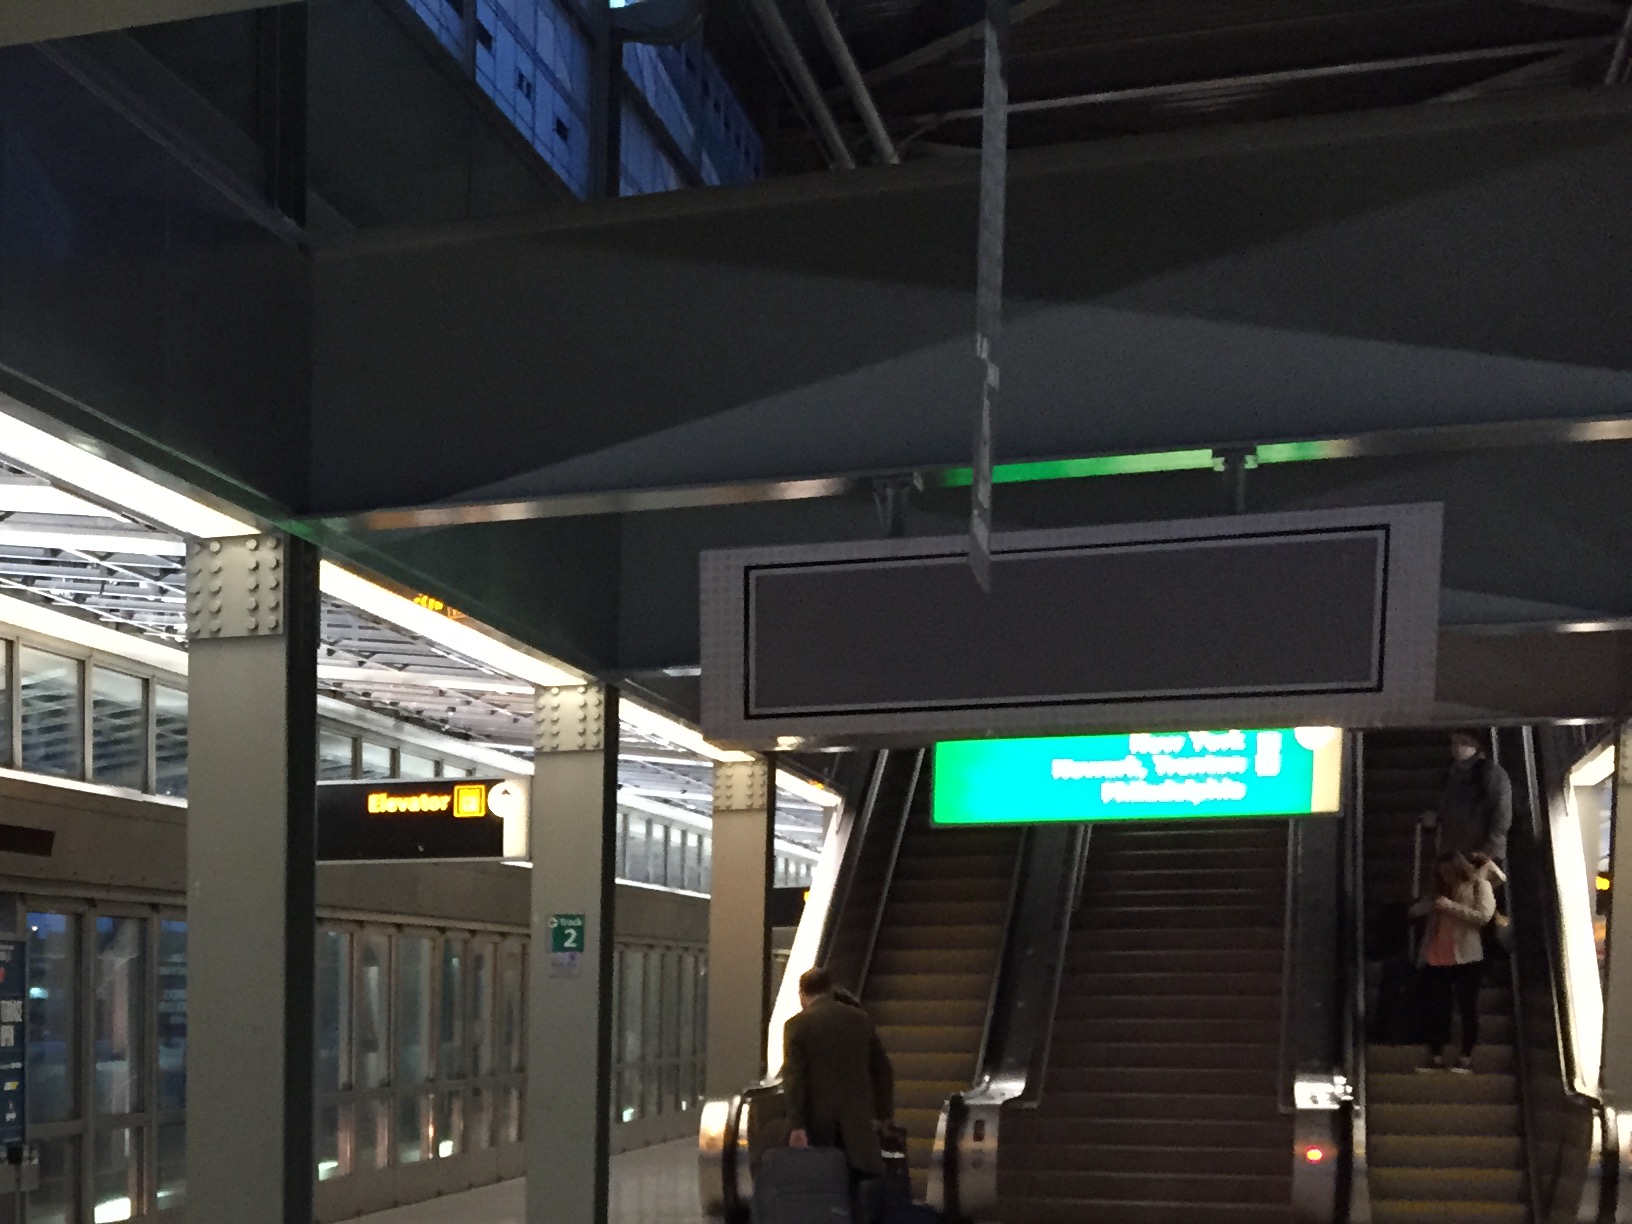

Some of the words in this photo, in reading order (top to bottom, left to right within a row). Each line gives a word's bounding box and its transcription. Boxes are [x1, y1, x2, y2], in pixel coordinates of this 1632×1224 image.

[1188, 729, 1246, 753] York
[1100, 776, 1248, 805] Philadelphia
[367, 792, 452, 814] Elevator
[564, 928, 578, 948] 2
